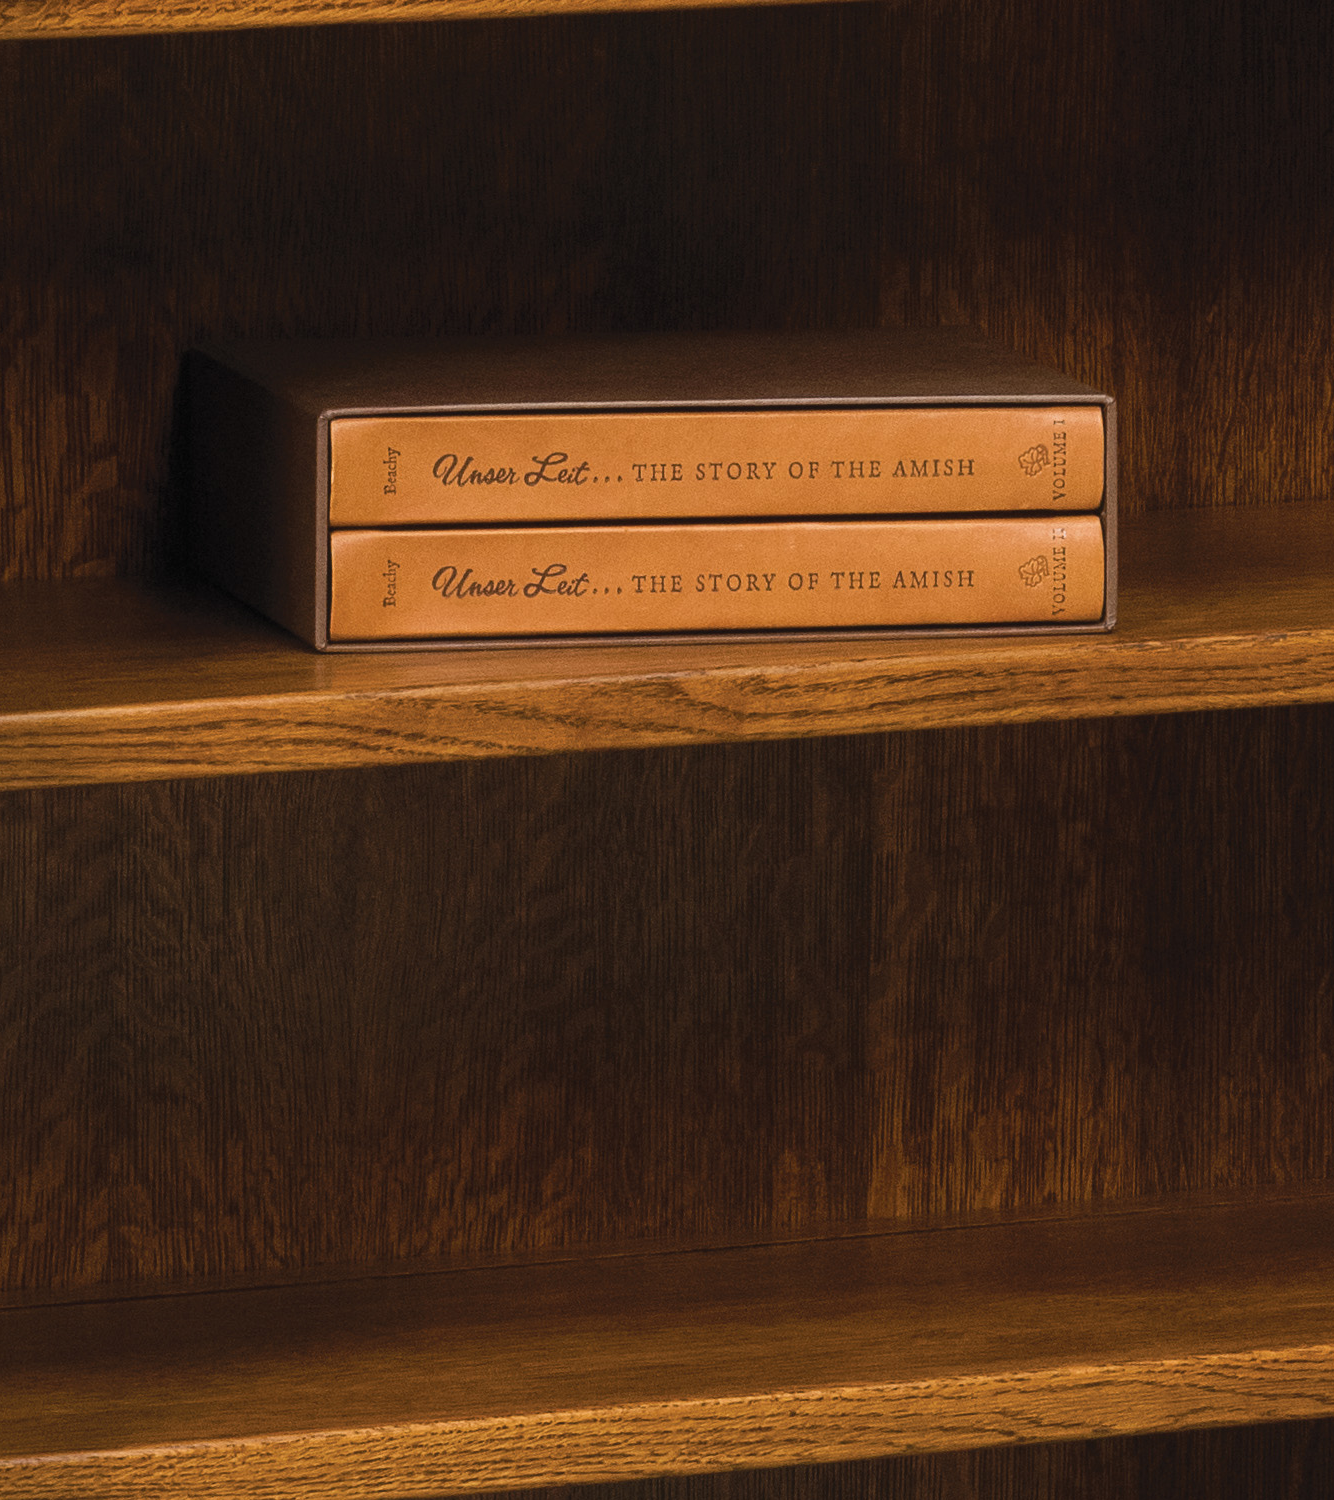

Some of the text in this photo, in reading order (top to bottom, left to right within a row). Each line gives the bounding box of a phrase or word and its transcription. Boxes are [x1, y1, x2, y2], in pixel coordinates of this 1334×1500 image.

[383, 446, 402, 496] Beachy
[432, 453, 520, 488] Unser
[632, 462, 684, 483] THE
[695, 460, 778, 482] STORY
[788, 461, 821, 480] OF
[830, 460, 882, 479] THE
[892, 458, 977, 479] AMISH
[1052, 431, 1068, 501] VOLUME
[382, 559, 401, 608] Beachy
[431, 565, 519, 600] Unser
[631, 574, 683, 594] THE
[695, 572, 777, 593] STORY
[787, 572, 820, 591] OF
[830, 571, 882, 590] THE
[892, 569, 976, 590] AMISH
[1051, 545, 1068, 616] VOLUME
